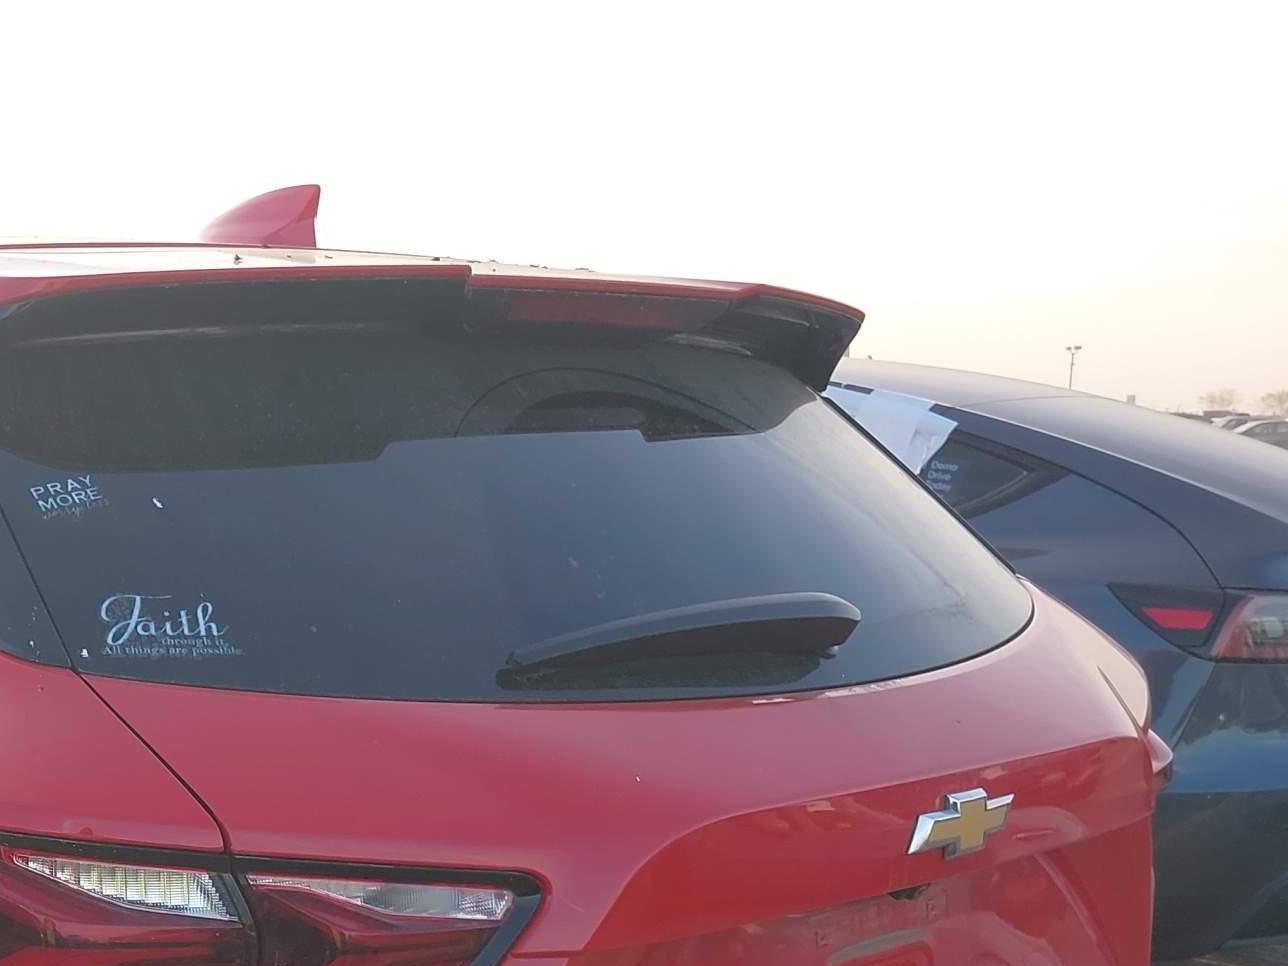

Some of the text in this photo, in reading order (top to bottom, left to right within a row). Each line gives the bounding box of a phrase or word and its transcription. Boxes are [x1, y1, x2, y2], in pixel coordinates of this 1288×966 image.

[29, 474, 91, 500] PRAY
[37, 487, 103, 512] MORE
[100, 594, 230, 646] Faith
[103, 645, 122, 656] All
